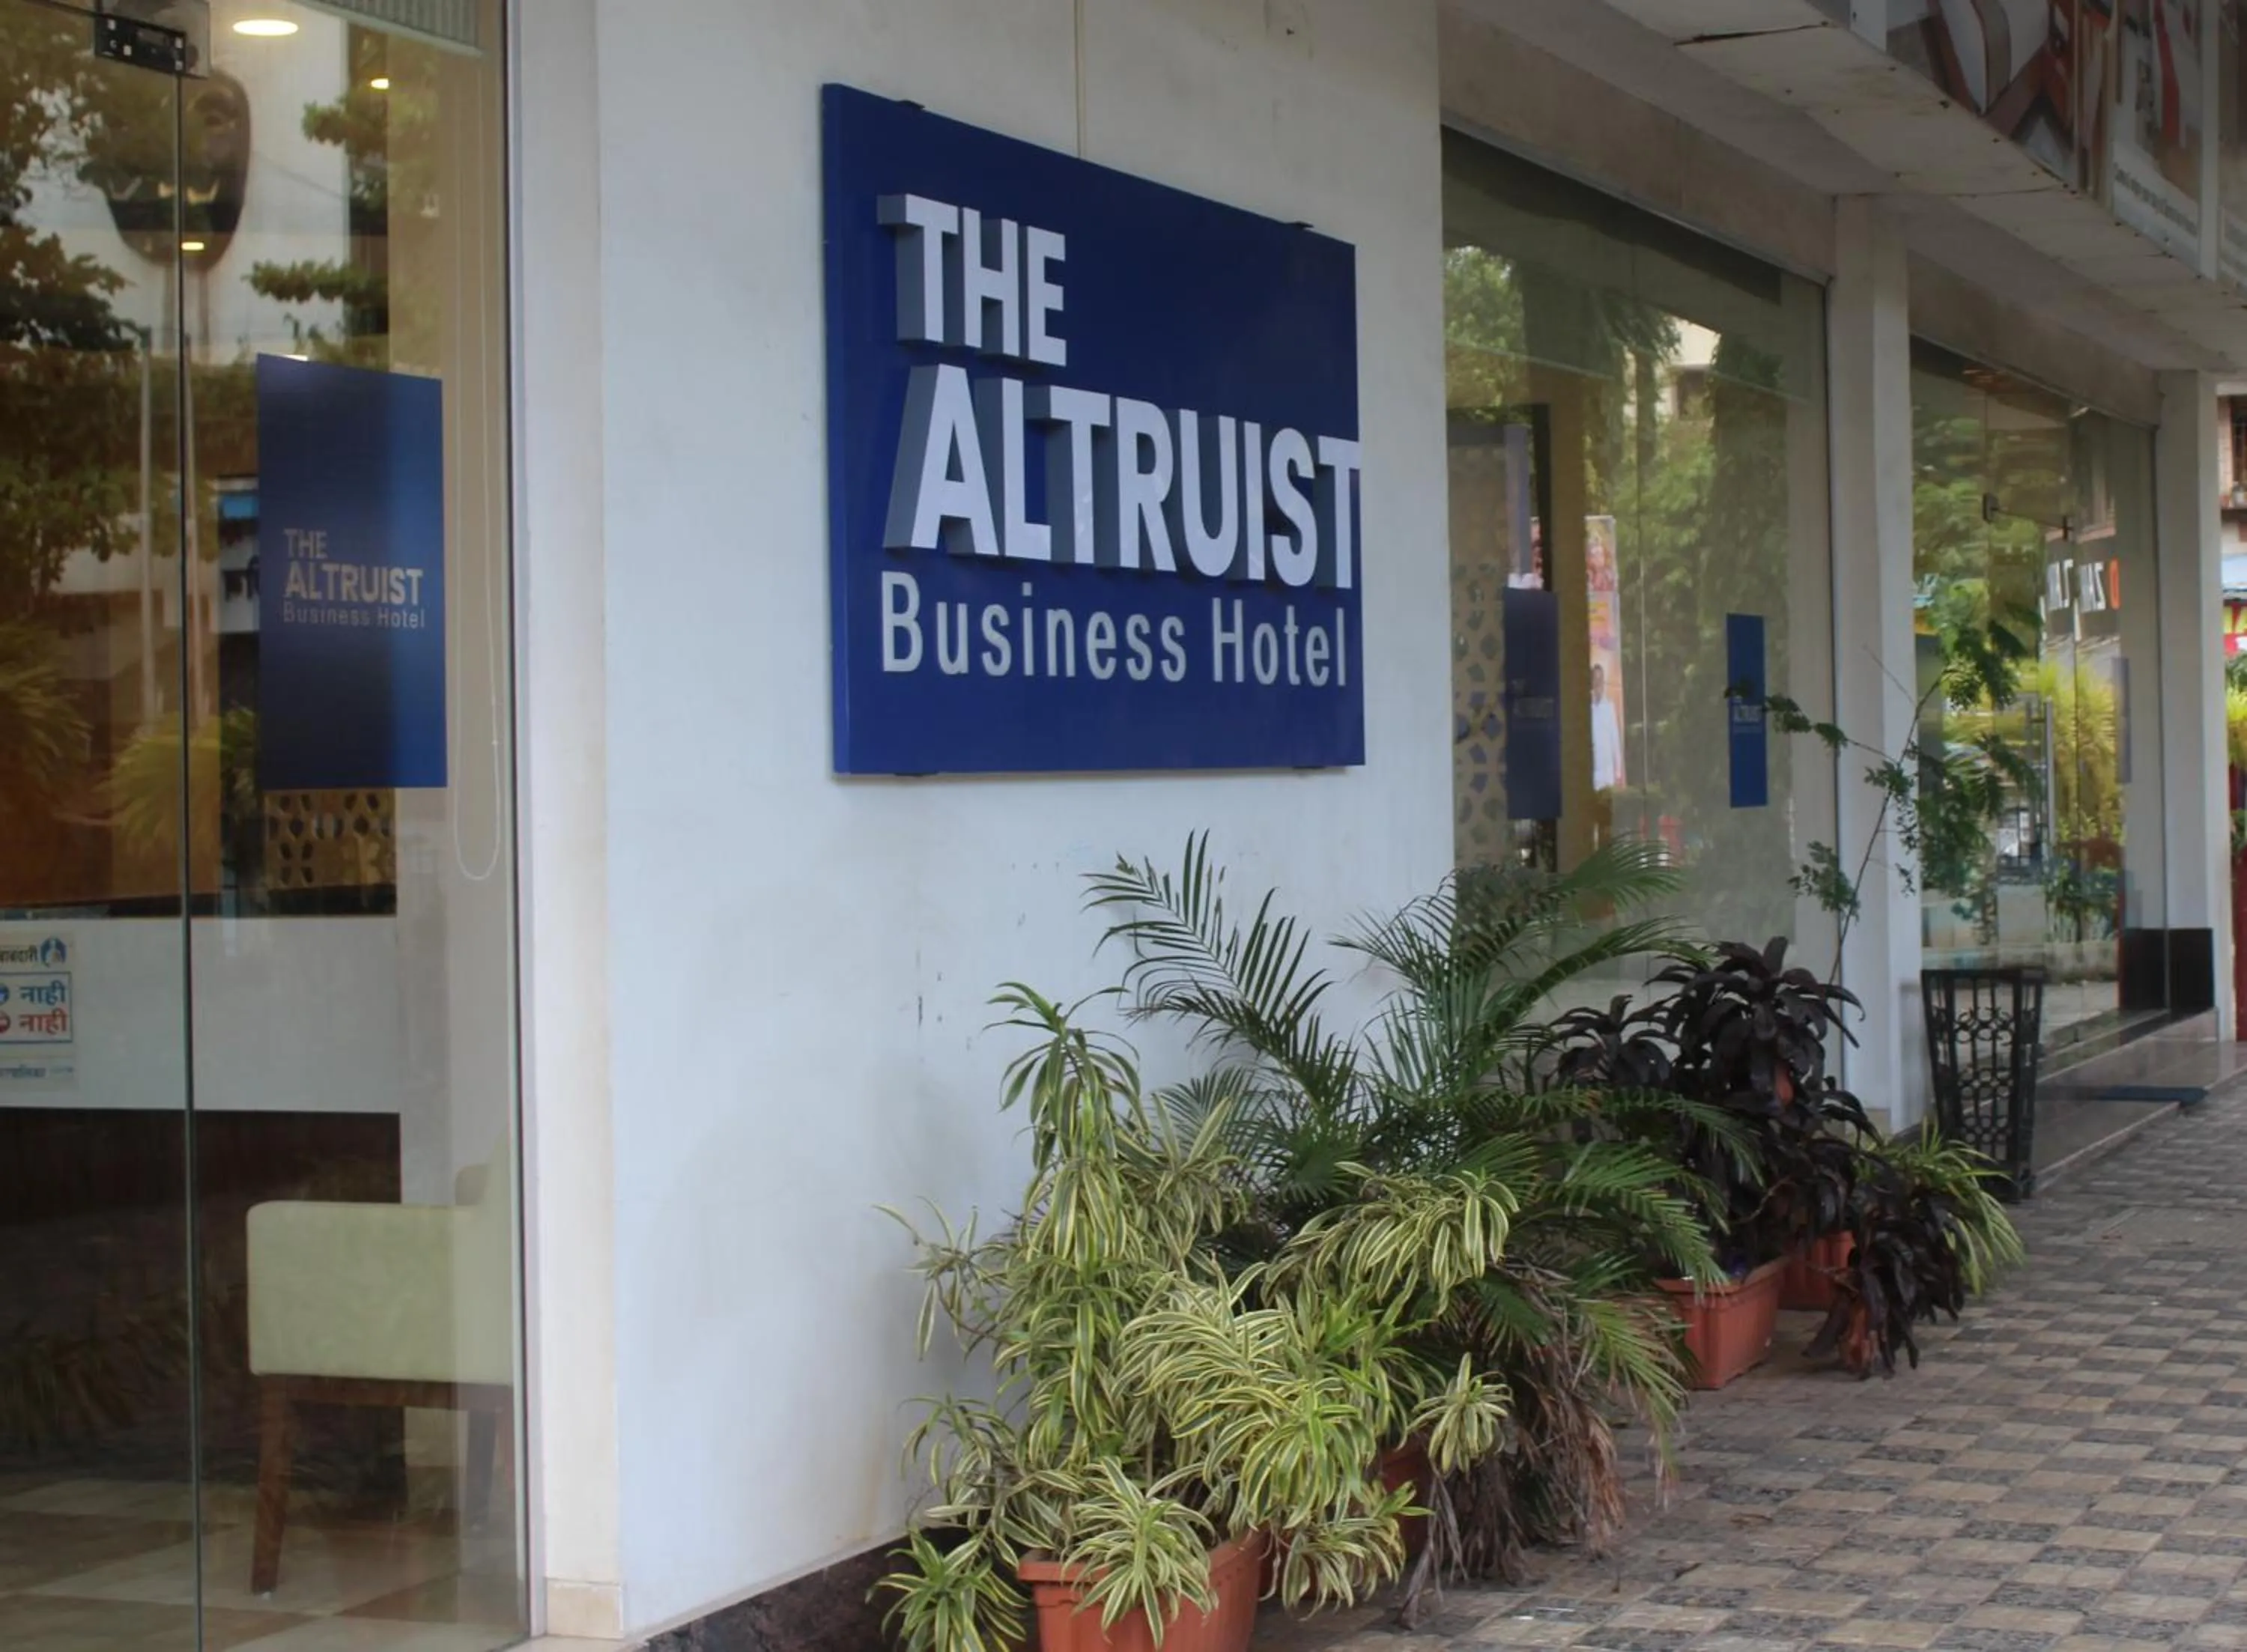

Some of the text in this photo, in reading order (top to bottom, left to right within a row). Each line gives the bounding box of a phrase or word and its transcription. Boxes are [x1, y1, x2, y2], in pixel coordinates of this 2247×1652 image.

[903, 192, 1067, 367] THE
[909, 362, 1361, 589] ALTRUIST
[283, 528, 328, 559] THE
[283, 560, 423, 605] ALTRUIST
[283, 601, 425, 629] Business Hotel
[881, 571, 1347, 687] Business Hotel
[19, 980, 67, 1006] नाही
[19, 1008, 68, 1035] नाही
